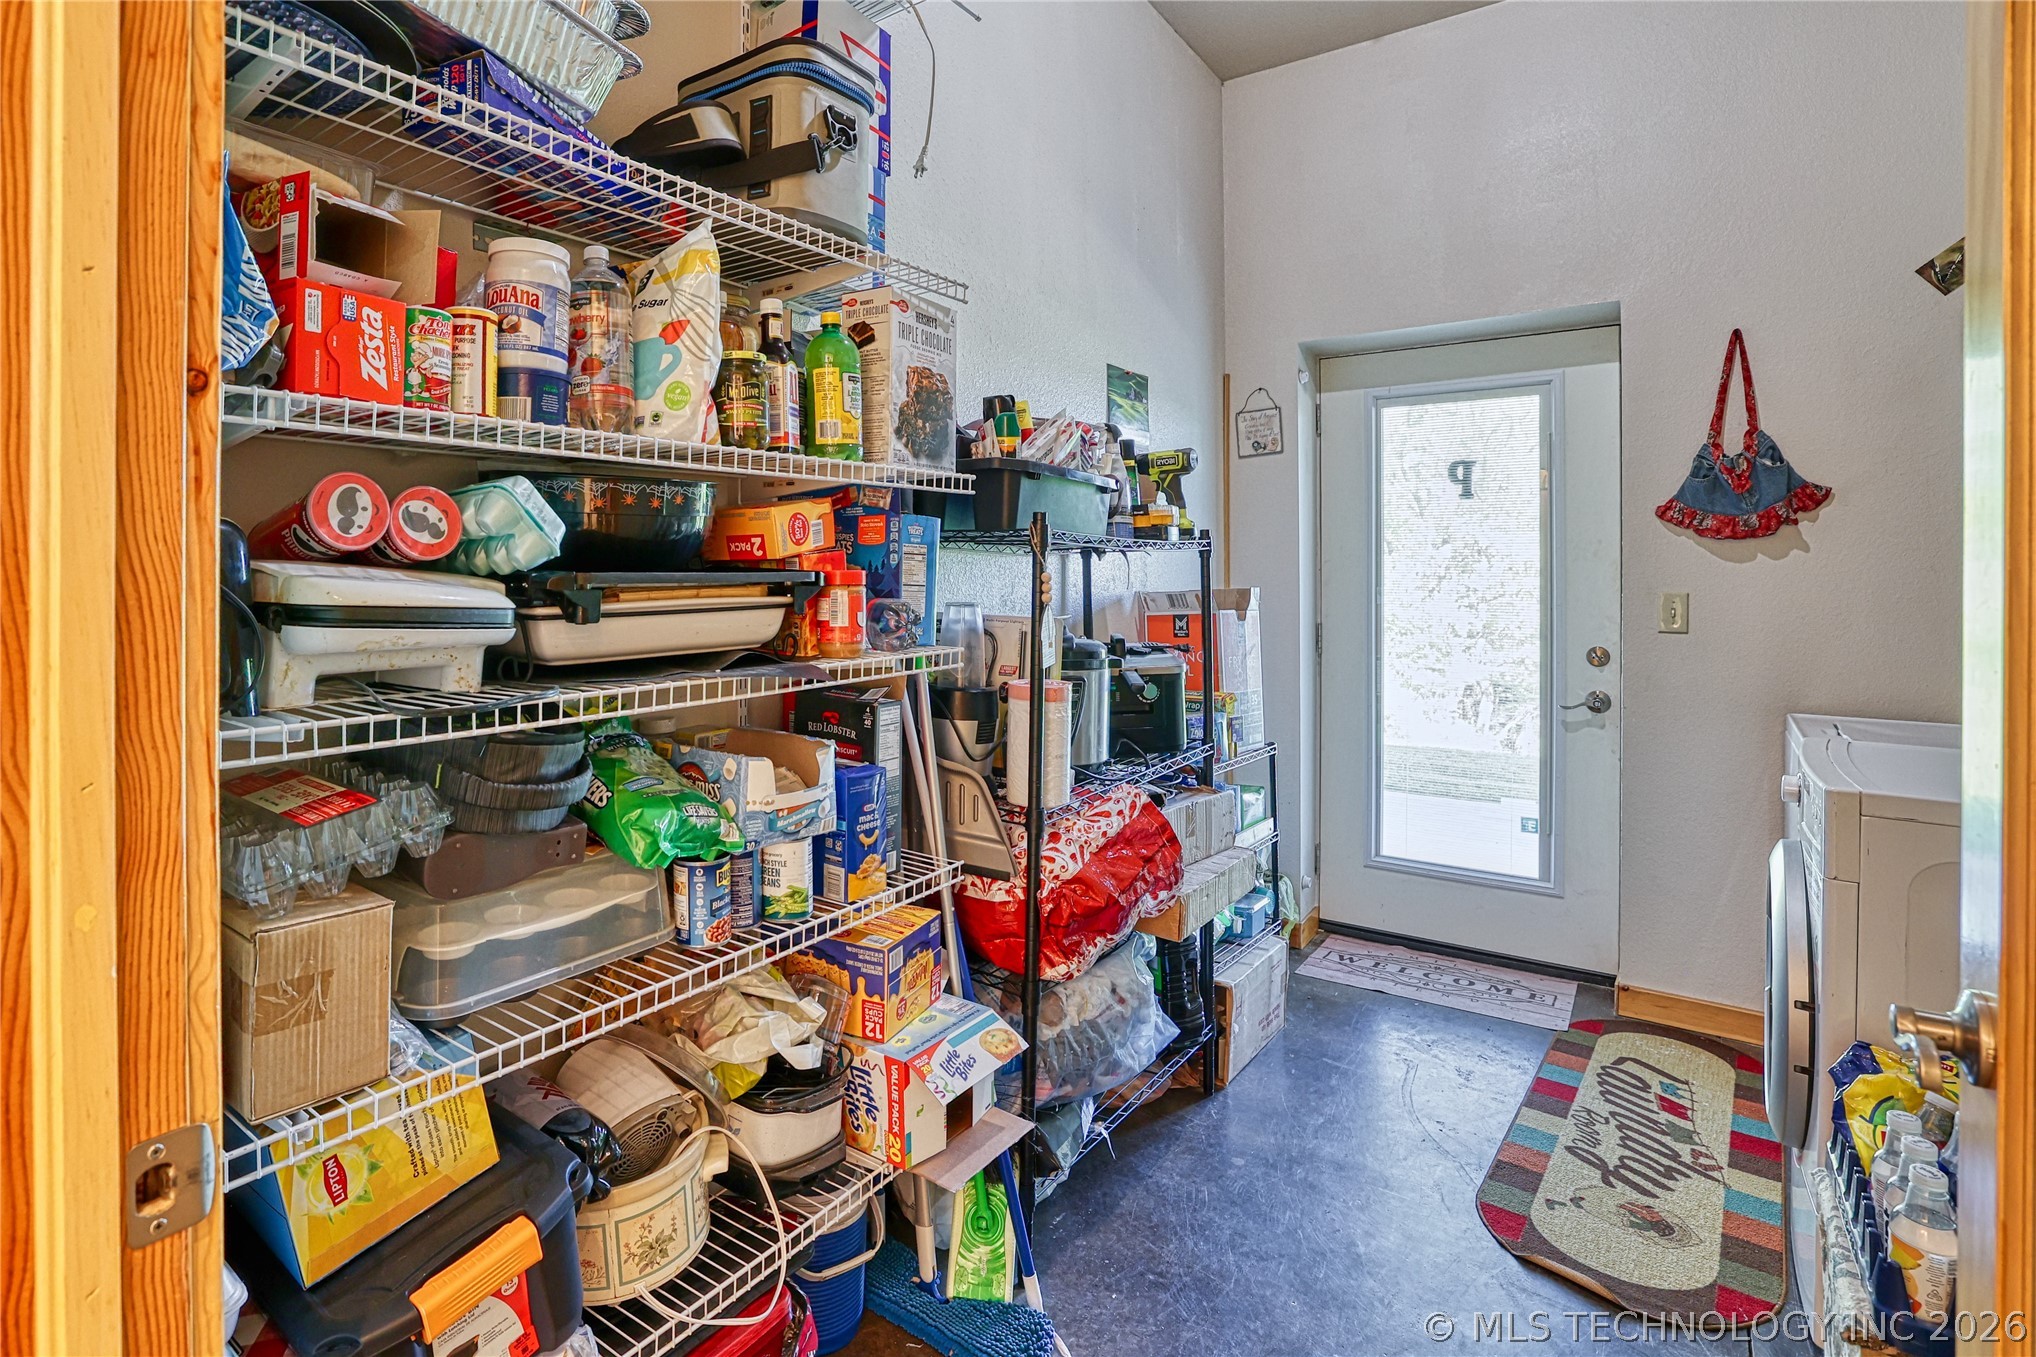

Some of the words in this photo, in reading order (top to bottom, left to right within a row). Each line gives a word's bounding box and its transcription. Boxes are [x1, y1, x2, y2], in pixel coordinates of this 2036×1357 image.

[451, 64, 460, 84] 120
[518, 307, 529, 317] OIL
[637, 298, 669, 309] Sugar
[845, 308, 860, 319] TRIPLE
[862, 303, 889, 317] CHOCOLATE
[915, 311, 938, 330] HERSHEY'S
[389, 325, 397, 343] Style
[897, 321, 919, 344] TRIPLE
[920, 329, 952, 356] CHOCOLATE
[360, 306, 388, 391] Zesta
[391, 344, 399, 381] Restaurant
[741, 386, 760, 398] Olive
[1157, 457, 1177, 466] RYOBI
[729, 542, 752, 552] PACK
[751, 537, 764, 557] 2
[808, 721, 823, 731] RED
[823, 722, 858, 740] LOBSTER
[777, 807, 817, 827] Marshmallow
[859, 814, 873, 823] mac
[745, 842, 756, 850] 30
[763, 868, 781, 877] REEN
[771, 860, 787, 868] STYLE
[763, 877, 781, 888] EANS
[1338, 953, 1547, 1003] WELCOME
[930, 984, 940, 1000] 12
[865, 1008, 883, 1017] CUPS
[865, 1015, 883, 1024] PACK
[865, 1021, 884, 1039] 12
[912, 1054, 928, 1067] VALUE
[921, 1064, 932, 1074] 20
[939, 1049, 961, 1078] Little
[955, 1054, 977, 1081] Bites
[890, 1065, 899, 1102] VALUE
[850, 1066, 877, 1122] Little
[891, 1104, 900, 1134] PACK
[1564, 1056, 1725, 1199] Laundry
[1571, 1105, 1611, 1150] Room
[403, 1132, 413, 1148] with
[889, 1134, 902, 1163] 20
[408, 1148, 420, 1178] Crafted
[323, 1158, 349, 1204] LIPTON
